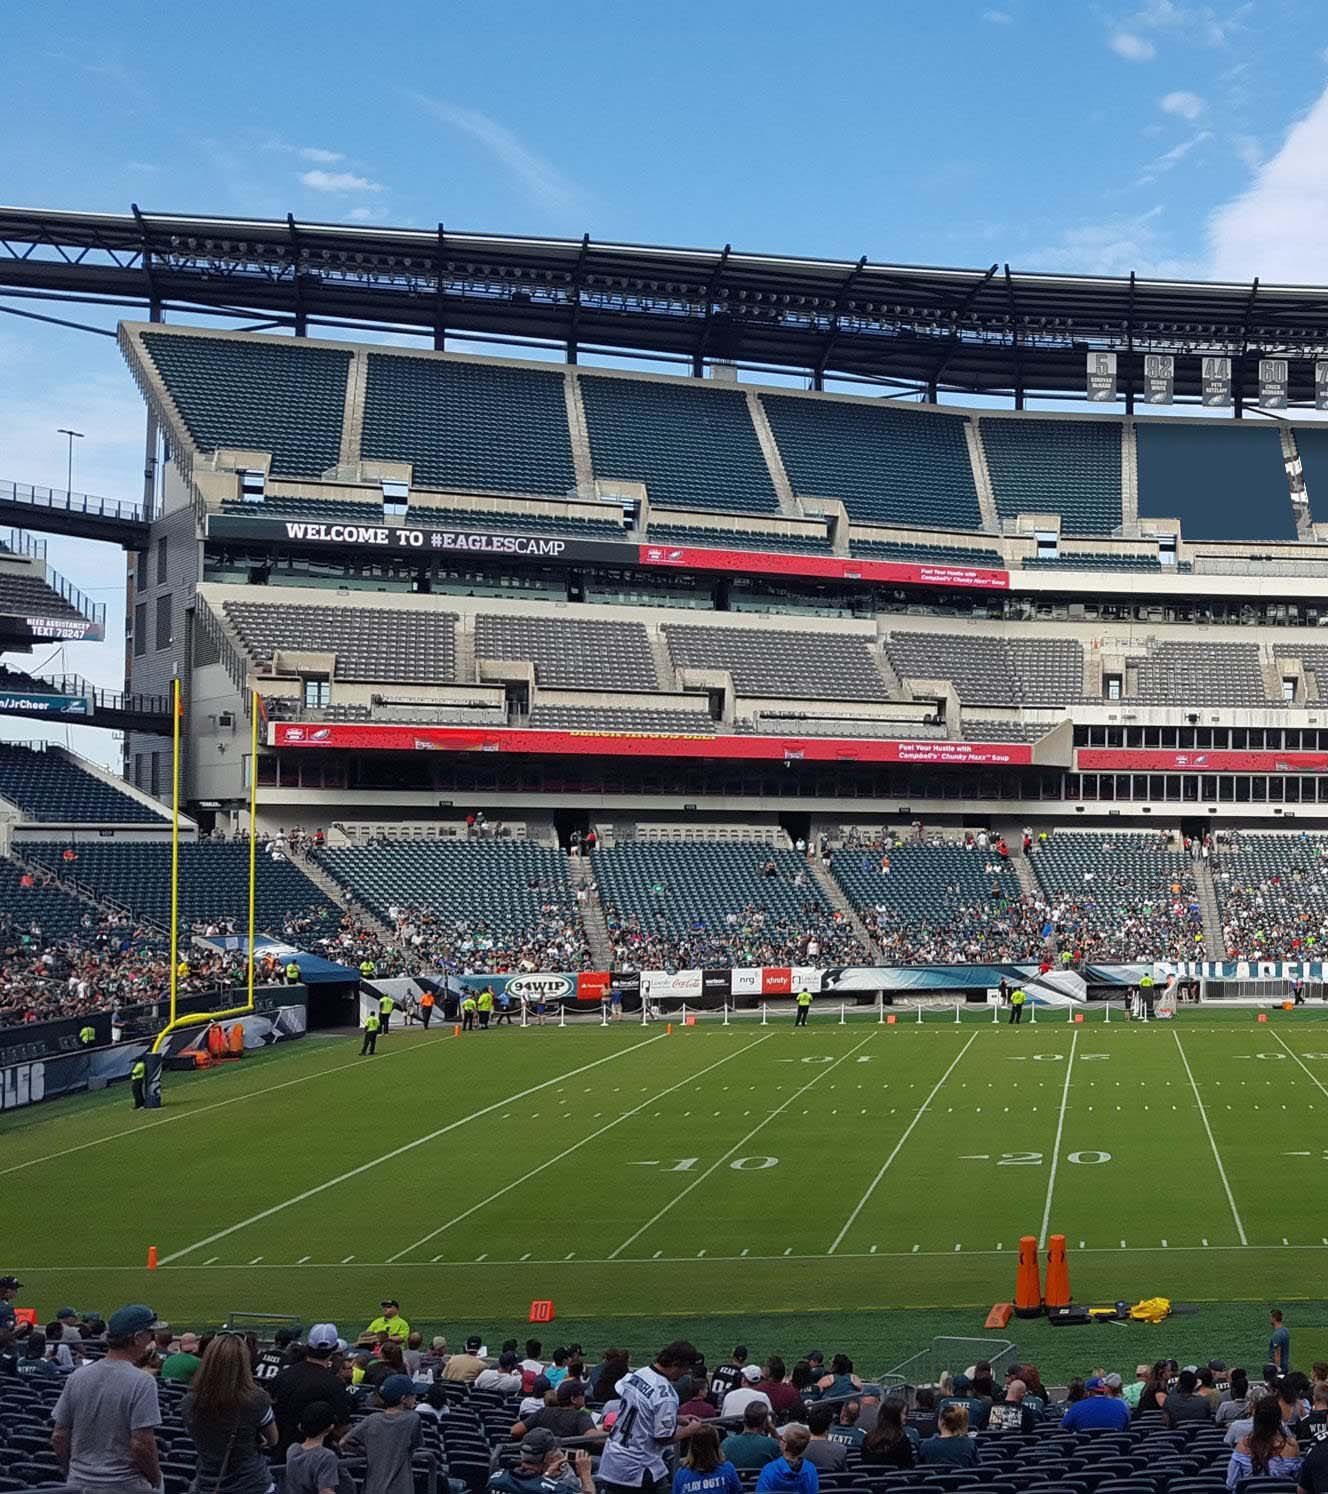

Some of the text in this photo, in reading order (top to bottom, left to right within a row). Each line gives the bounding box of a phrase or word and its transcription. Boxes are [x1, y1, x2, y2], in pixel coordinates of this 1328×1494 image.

[1096, 354, 1109, 376] 5
[1147, 356, 1172, 379] 92
[1205, 358, 1229, 380] 44
[1260, 360, 1286, 383] 60
[285, 523, 566, 556] WELCOME TO #EAGLESCAMP
[32, 626, 53, 636] TEXT
[0, 698, 50, 710] /JrCheer
[514, 981, 565, 992] 94WIP
[740, 977, 755, 985] nrg
[660, 1156, 779, 1171] 10
[996, 1152, 1112, 1165] 20
[534, 1303, 549, 1320] 10
